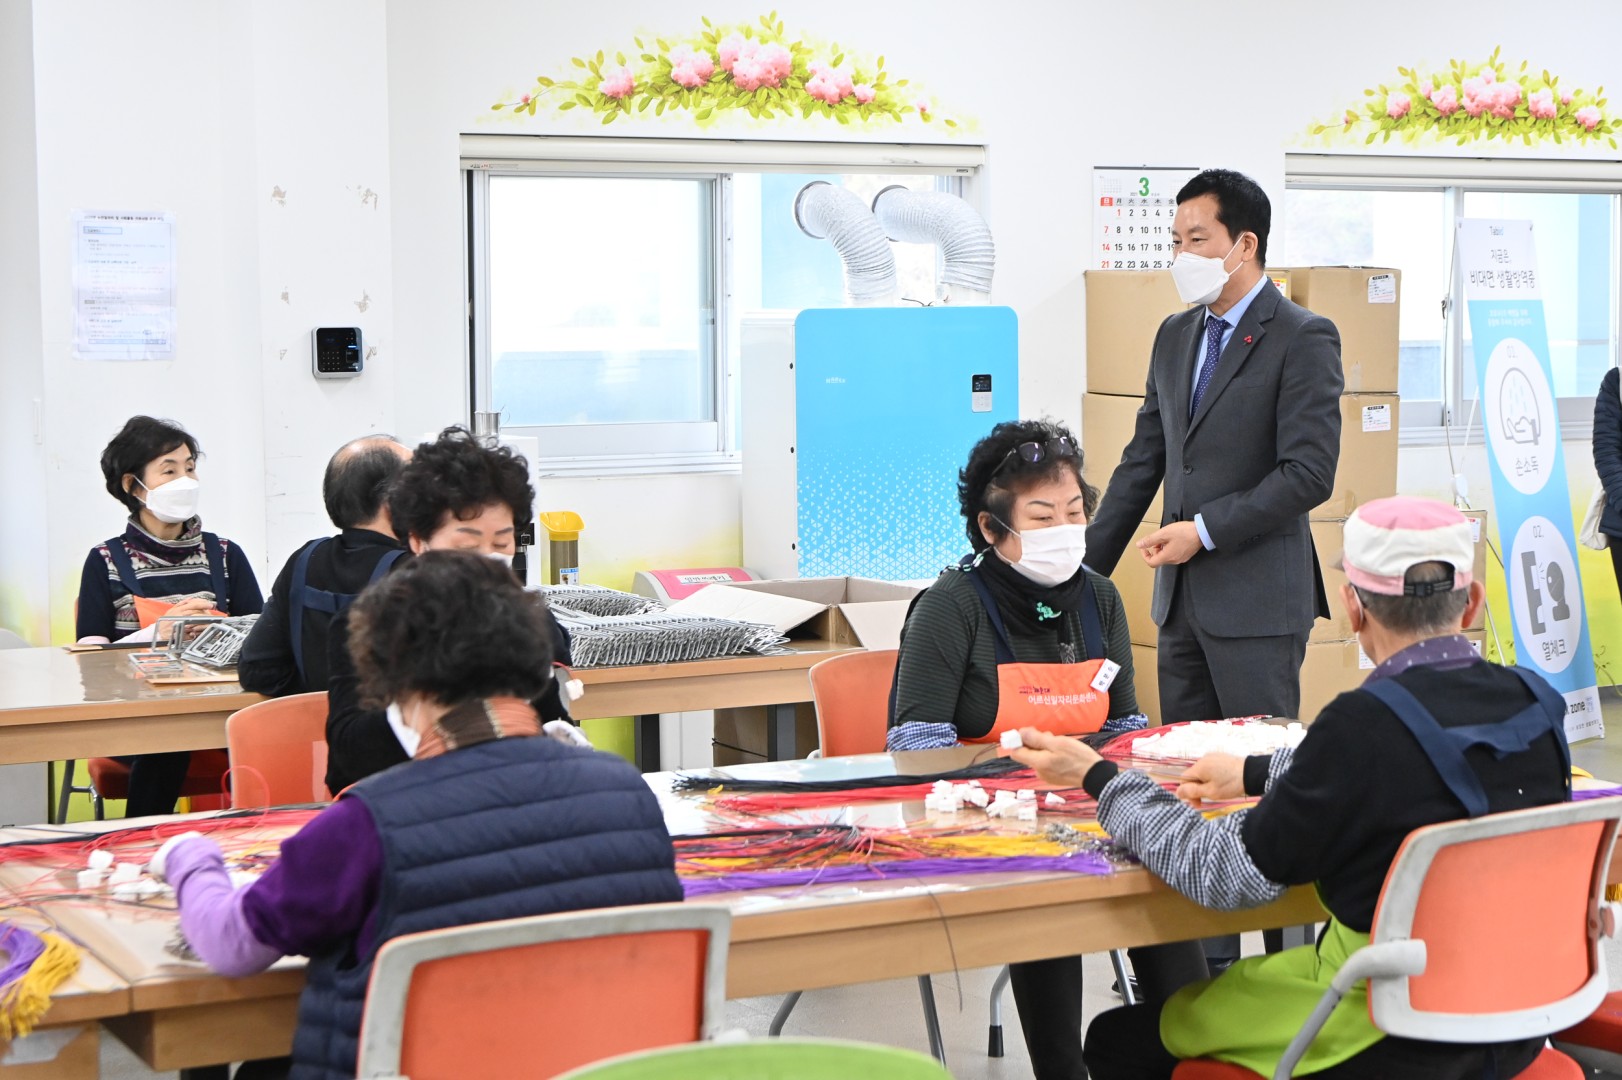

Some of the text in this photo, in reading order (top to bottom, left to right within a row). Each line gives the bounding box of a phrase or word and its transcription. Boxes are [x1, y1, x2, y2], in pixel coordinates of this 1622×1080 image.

[1138, 177, 1150, 197] 3
[1117, 209, 1174, 217] 1 2 3 4 5
[1104, 225, 1109, 234] 7
[1116, 225, 1121, 234] 8
[1129, 225, 1134, 234] 9
[1140, 225, 1149, 234] 10
[1154, 225, 1162, 234] 11
[1102, 243, 1110, 251] 14
[1115, 243, 1123, 251] 15
[1127, 243, 1136, 251] 16
[1140, 243, 1149, 251] 17
[1154, 243, 1162, 251] 18
[1101, 261, 1109, 269] 21
[1114, 261, 1123, 269] 22
[1127, 261, 1136, 269] 23
[1140, 261, 1149, 269] 24
[1153, 261, 1162, 269] 25
[1469, 270, 1536, 289] 비대면 생활방역중
[1515, 456, 1539, 477] 손소독
[1542, 639, 1567, 661] 열체크
[1028, 691, 1098, 706] 어르신일자리문화센터
[1570, 701, 1586, 714] zone
